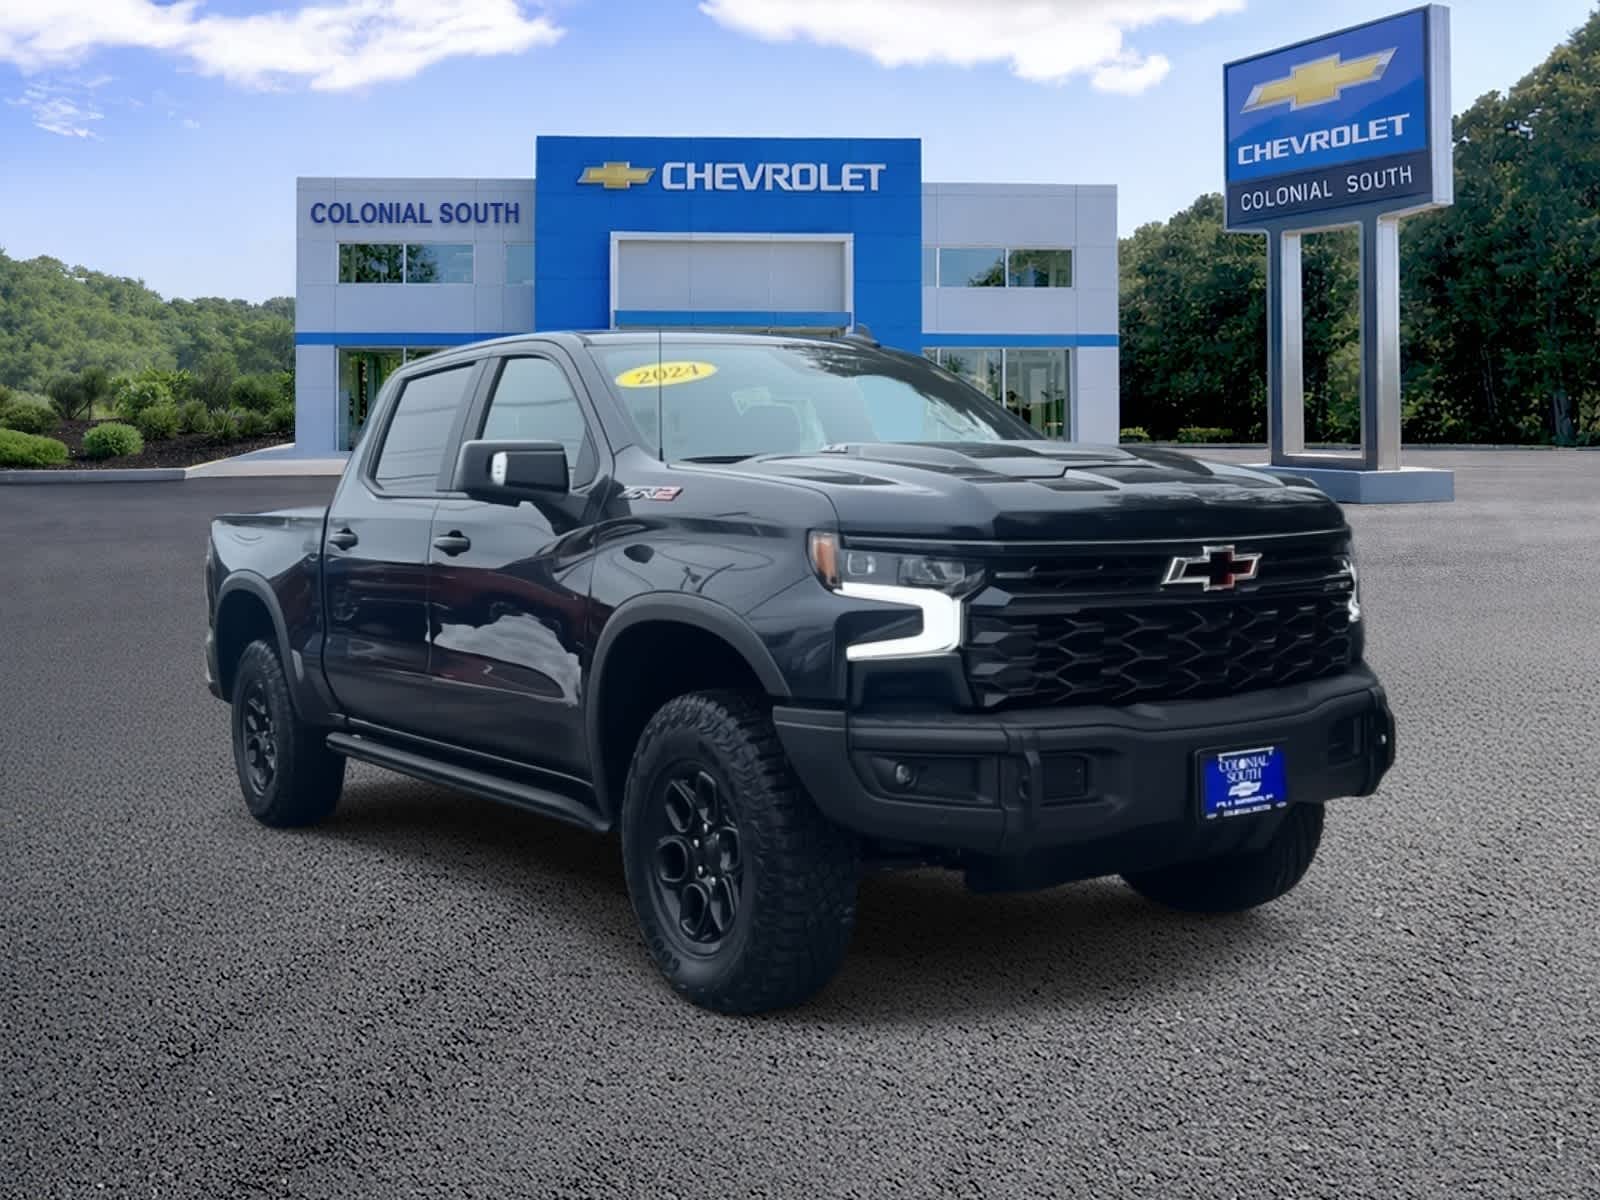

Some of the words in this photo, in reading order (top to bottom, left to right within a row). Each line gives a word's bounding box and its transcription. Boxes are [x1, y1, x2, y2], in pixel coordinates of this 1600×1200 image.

[1238, 113, 1410, 165] CHEVROLET
[662, 162, 887, 192] CHEVROLET
[1241, 180, 1333, 211] COLONIAL
[1346, 165, 1412, 193] SOUTH
[310, 202, 432, 224] COLONIAL
[439, 202, 520, 224] SOUTH
[637, 364, 699, 384] 2024
